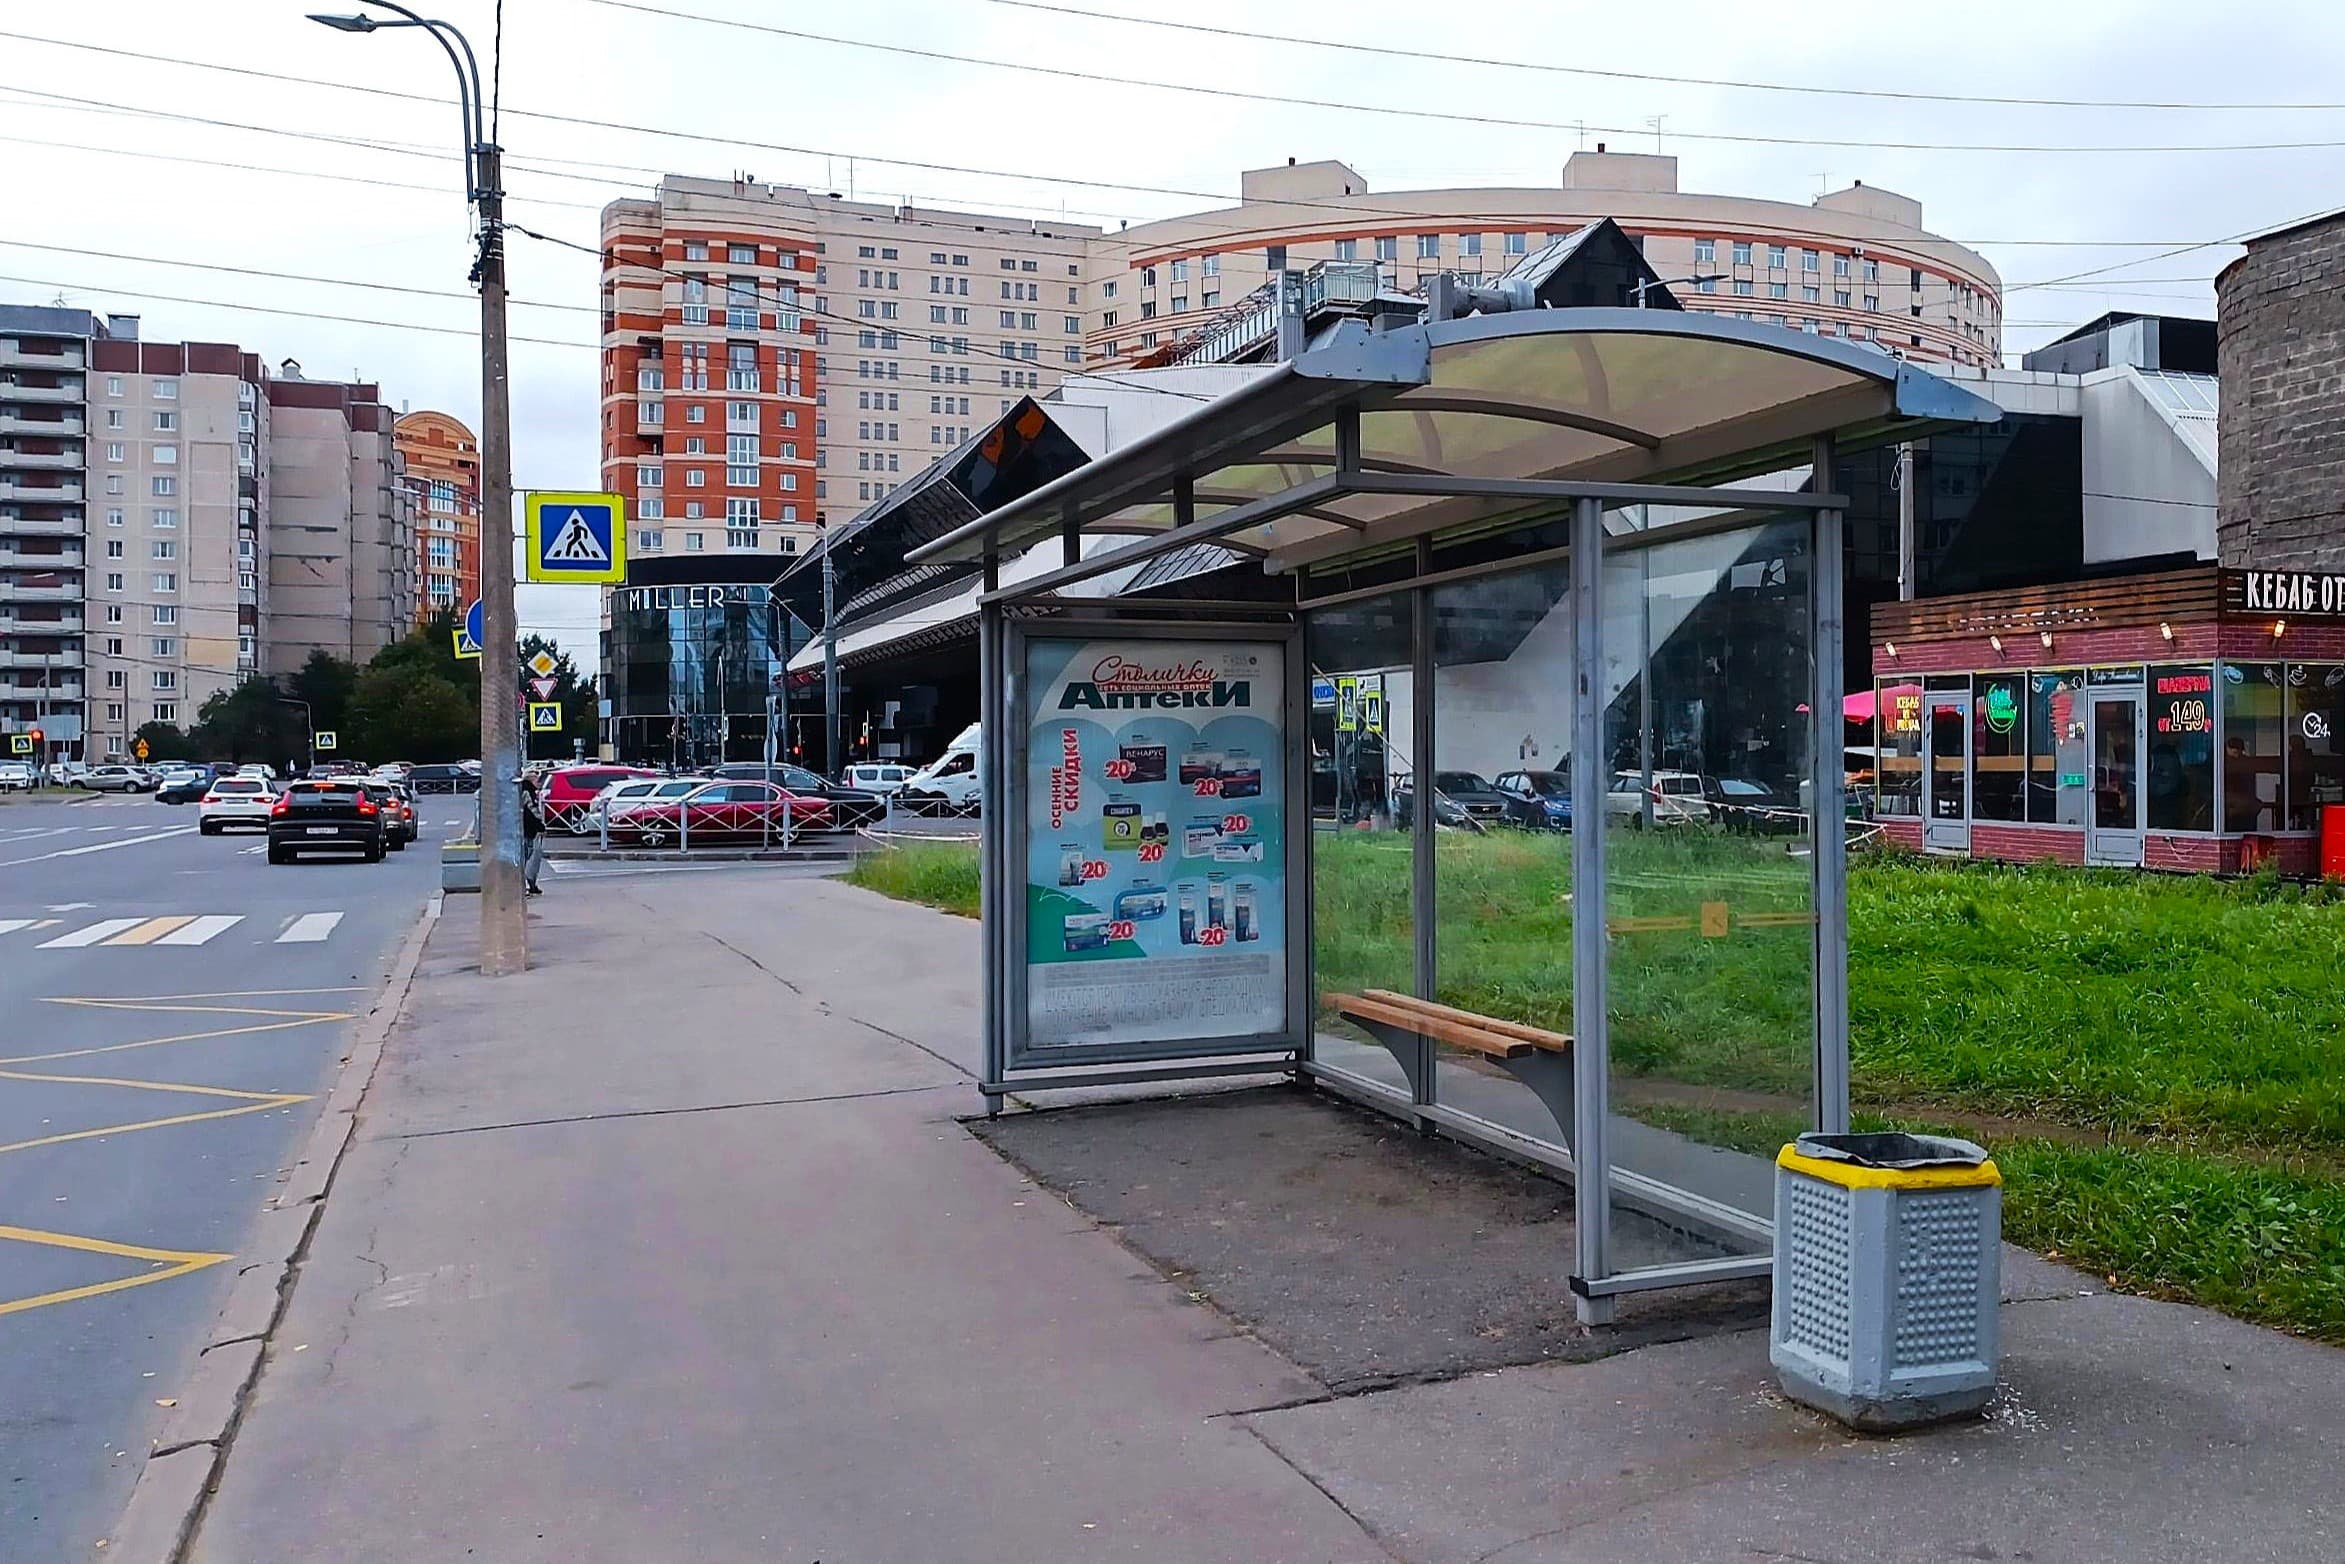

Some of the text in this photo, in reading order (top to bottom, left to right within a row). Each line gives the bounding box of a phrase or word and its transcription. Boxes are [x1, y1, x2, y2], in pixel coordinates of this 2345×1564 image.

[629, 586, 724, 612] MILLER
[2247, 572, 2345, 612] КЕБАБ ОТ
[1063, 729, 1081, 812] СКИДКИ
[1051, 766, 1062, 829] ОСЕННИЕ
